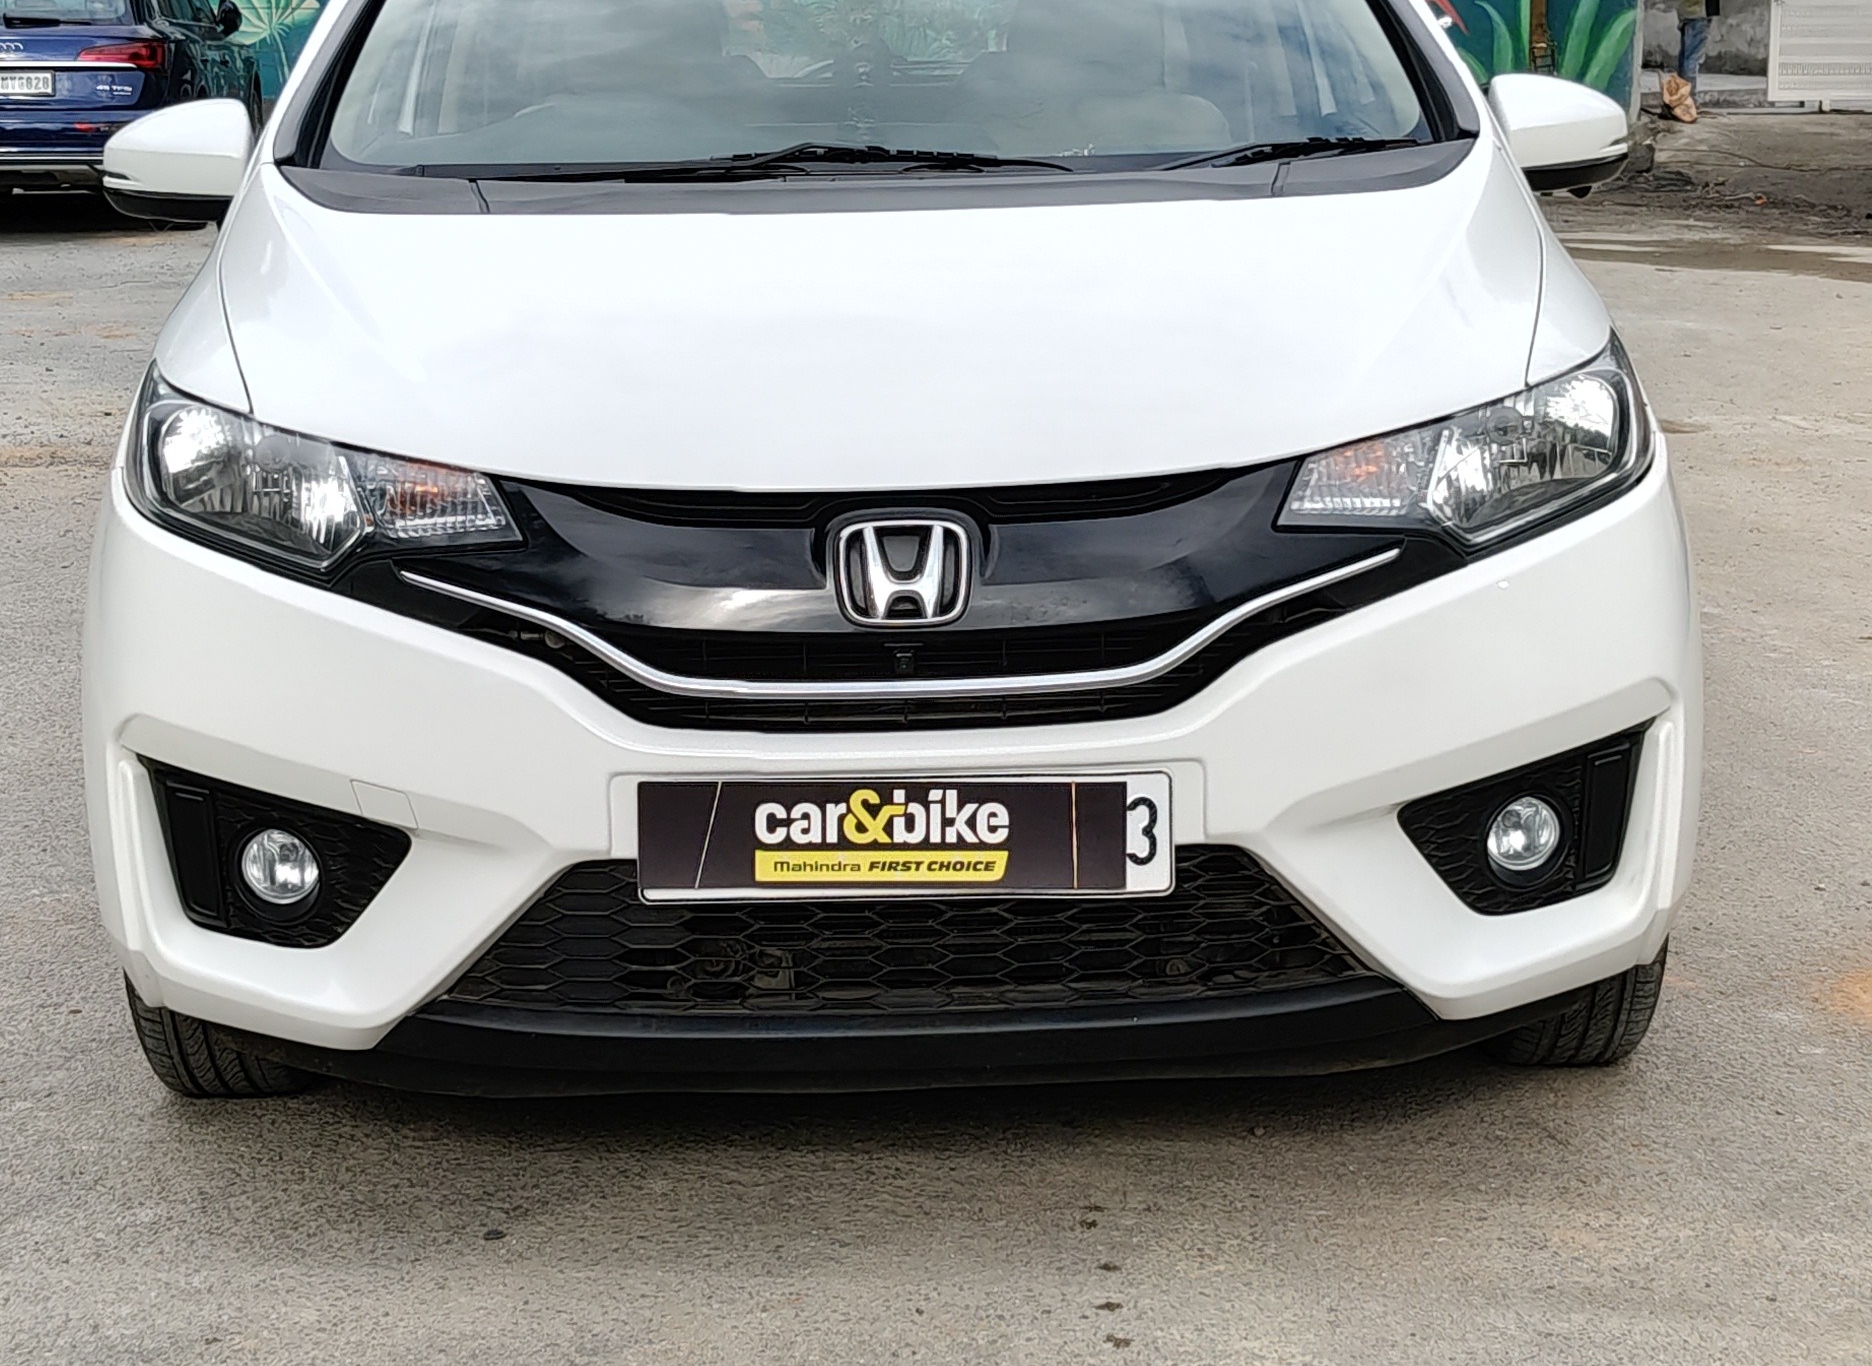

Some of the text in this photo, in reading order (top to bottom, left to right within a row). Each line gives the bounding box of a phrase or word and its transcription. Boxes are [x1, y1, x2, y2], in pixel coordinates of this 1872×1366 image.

[755, 789, 1010, 844] car&bike
[773, 860, 997, 872] Mahindra FIRST CHOICE
